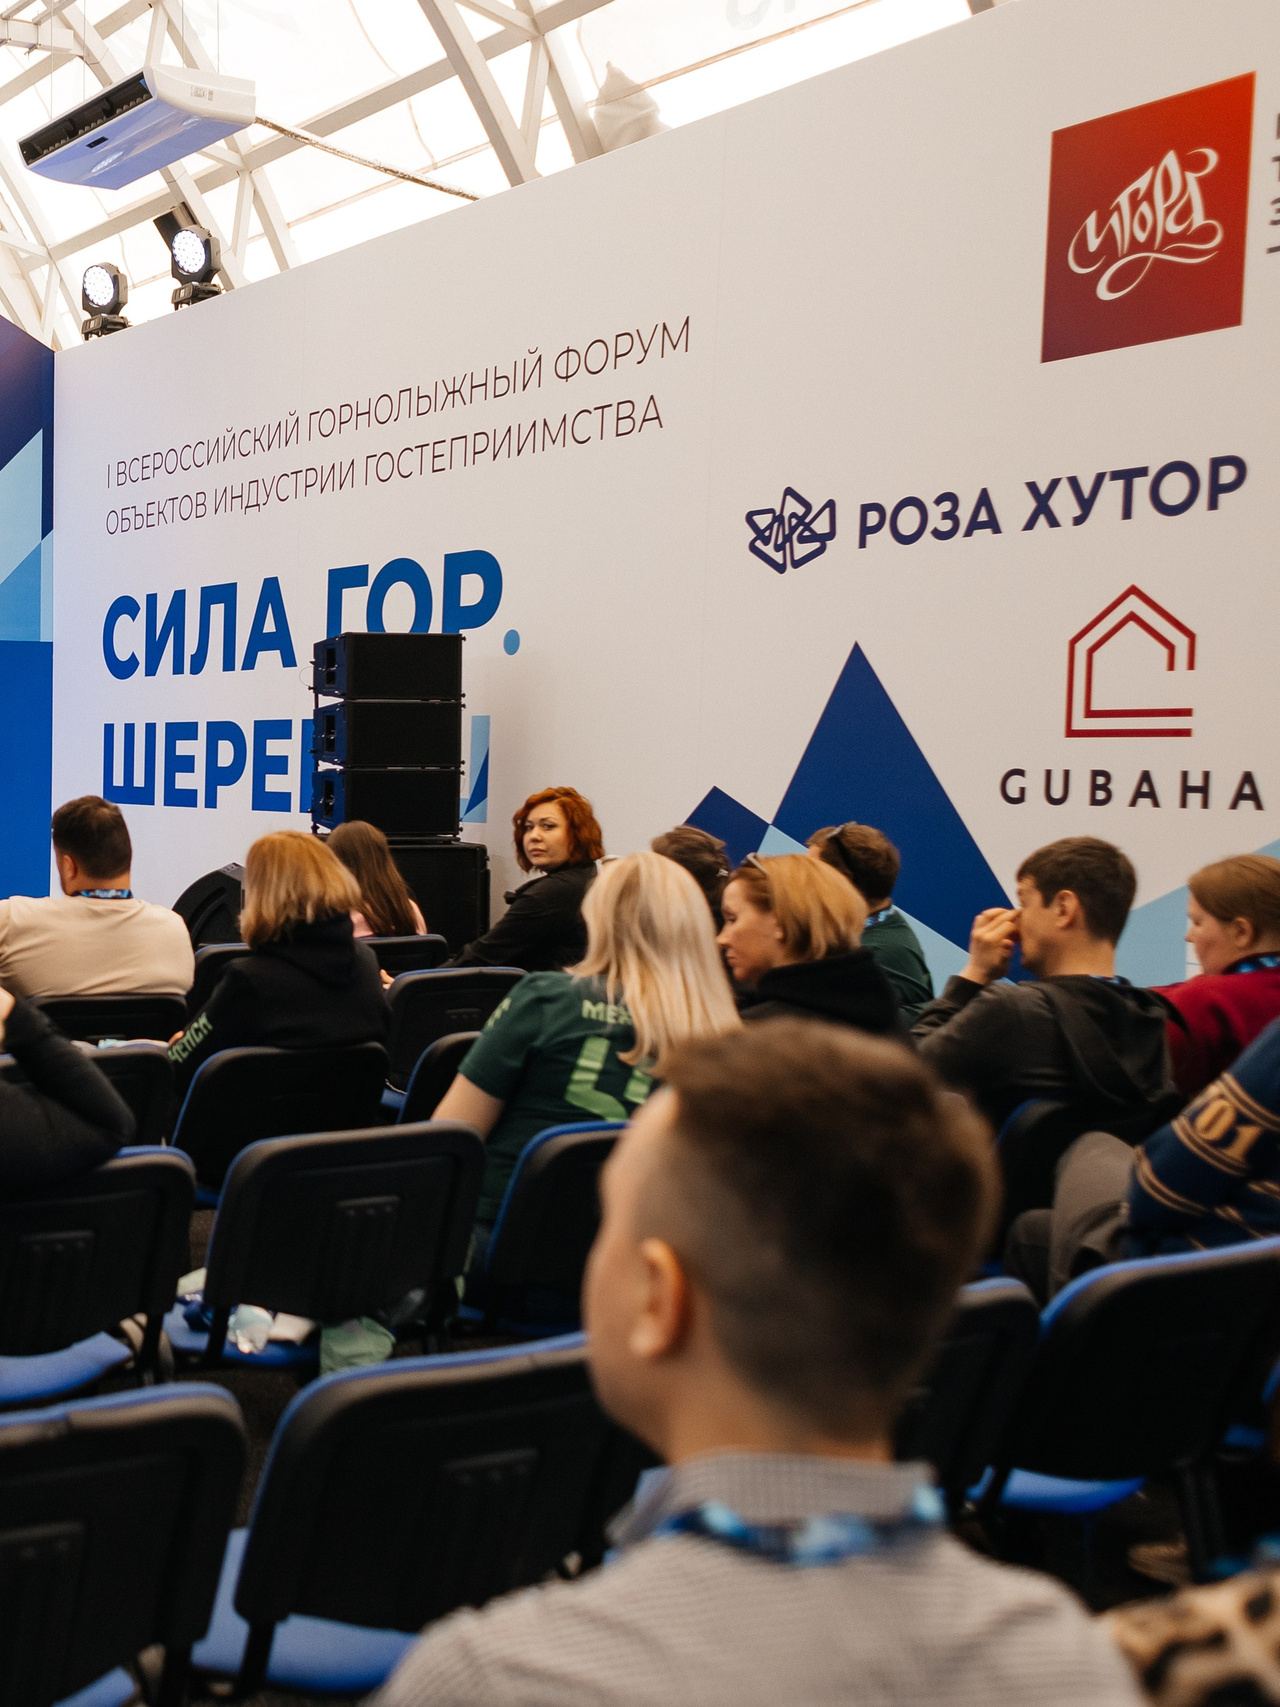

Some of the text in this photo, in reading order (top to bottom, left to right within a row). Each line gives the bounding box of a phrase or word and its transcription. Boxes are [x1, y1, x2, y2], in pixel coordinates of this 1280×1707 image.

[116, 409, 300, 487] ВСЕРОССИЙСКИЙ
[308, 346, 543, 442] ГОРНОЛЫЖНЫЙ
[554, 315, 691, 383] ФОРУМ
[105, 394, 664, 535] ОБЪЕКТОВ ИНДУСТРИИ ГОСТЕПРИИМСТВА
[858, 454, 1248, 550] РОЗА ХУТОР
[102, 575, 298, 681] СИЛА
[1000, 768, 1265, 812] GUBAHA
